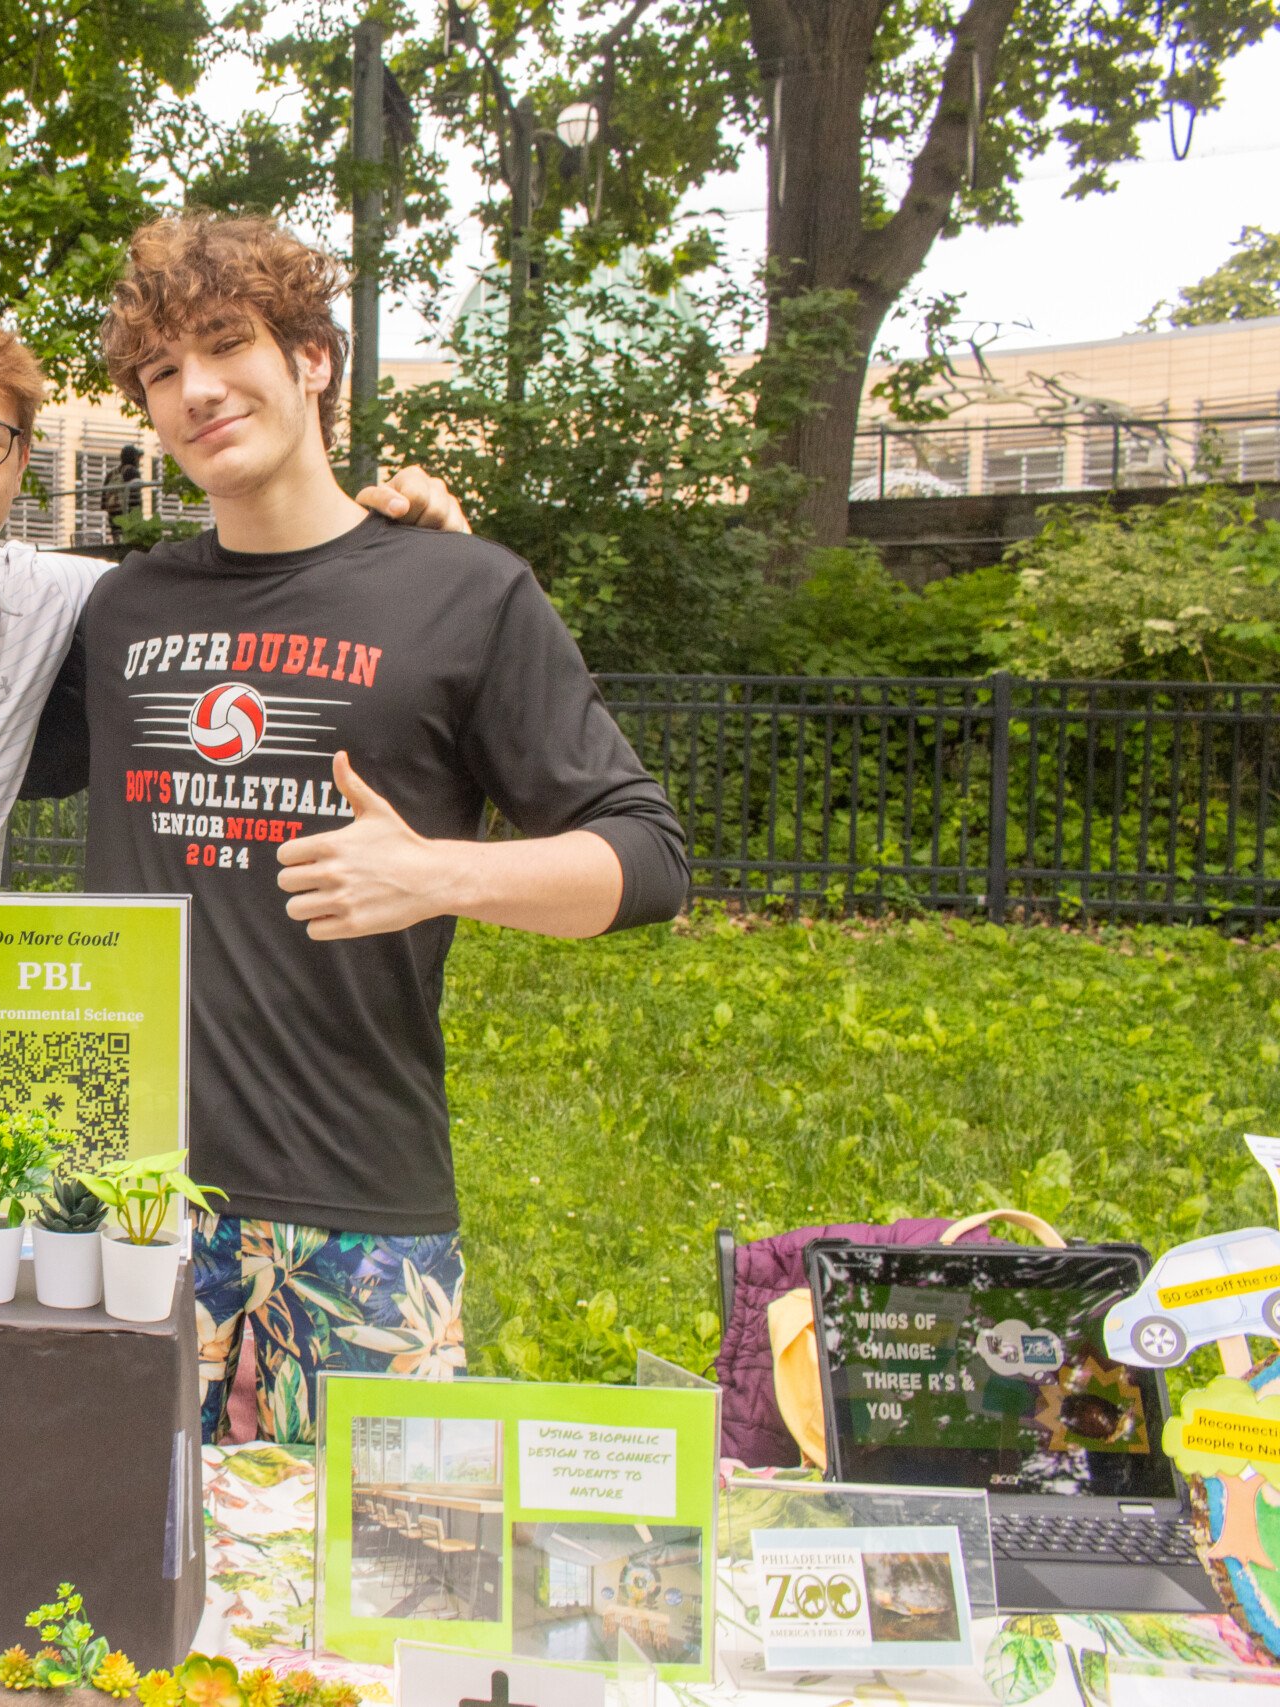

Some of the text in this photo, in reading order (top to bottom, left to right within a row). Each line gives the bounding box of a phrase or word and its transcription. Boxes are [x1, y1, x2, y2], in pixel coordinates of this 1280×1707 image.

[124, 632, 383, 688] UPPER DUBLIN
[126, 770, 170, 803] BOY'S
[226, 817, 302, 842] NIGHT
[186, 844, 249, 869] 2024
[18, 931, 63, 946] More
[68, 931, 120, 947] Good!
[17, 962, 92, 991] PBL
[84, 1007, 144, 1022] Science
[1163, 1272, 1280, 1303] 50 cars off the ro
[854, 1313, 936, 1330] WINGS OF
[860, 1342, 936, 1360] CHANGE:
[862, 1372, 922, 1390] THREE
[928, 1372, 956, 1391] R'S
[866, 1402, 902, 1420] YOU
[539, 1428, 660, 1445] USING BIOPHILIC
[1187, 1435, 1234, 1449] people
[1239, 1441, 1253, 1452] to
[528, 1447, 672, 1465] DESIGN TO CONNECT
[552, 1466, 642, 1482] STUDENTS TO
[570, 1487, 624, 1499] NATURE
[761, 1554, 855, 1565] PHILADELPHIA
[765, 1573, 862, 1620] ZOO
[819, 1629, 843, 1638] FIRST
